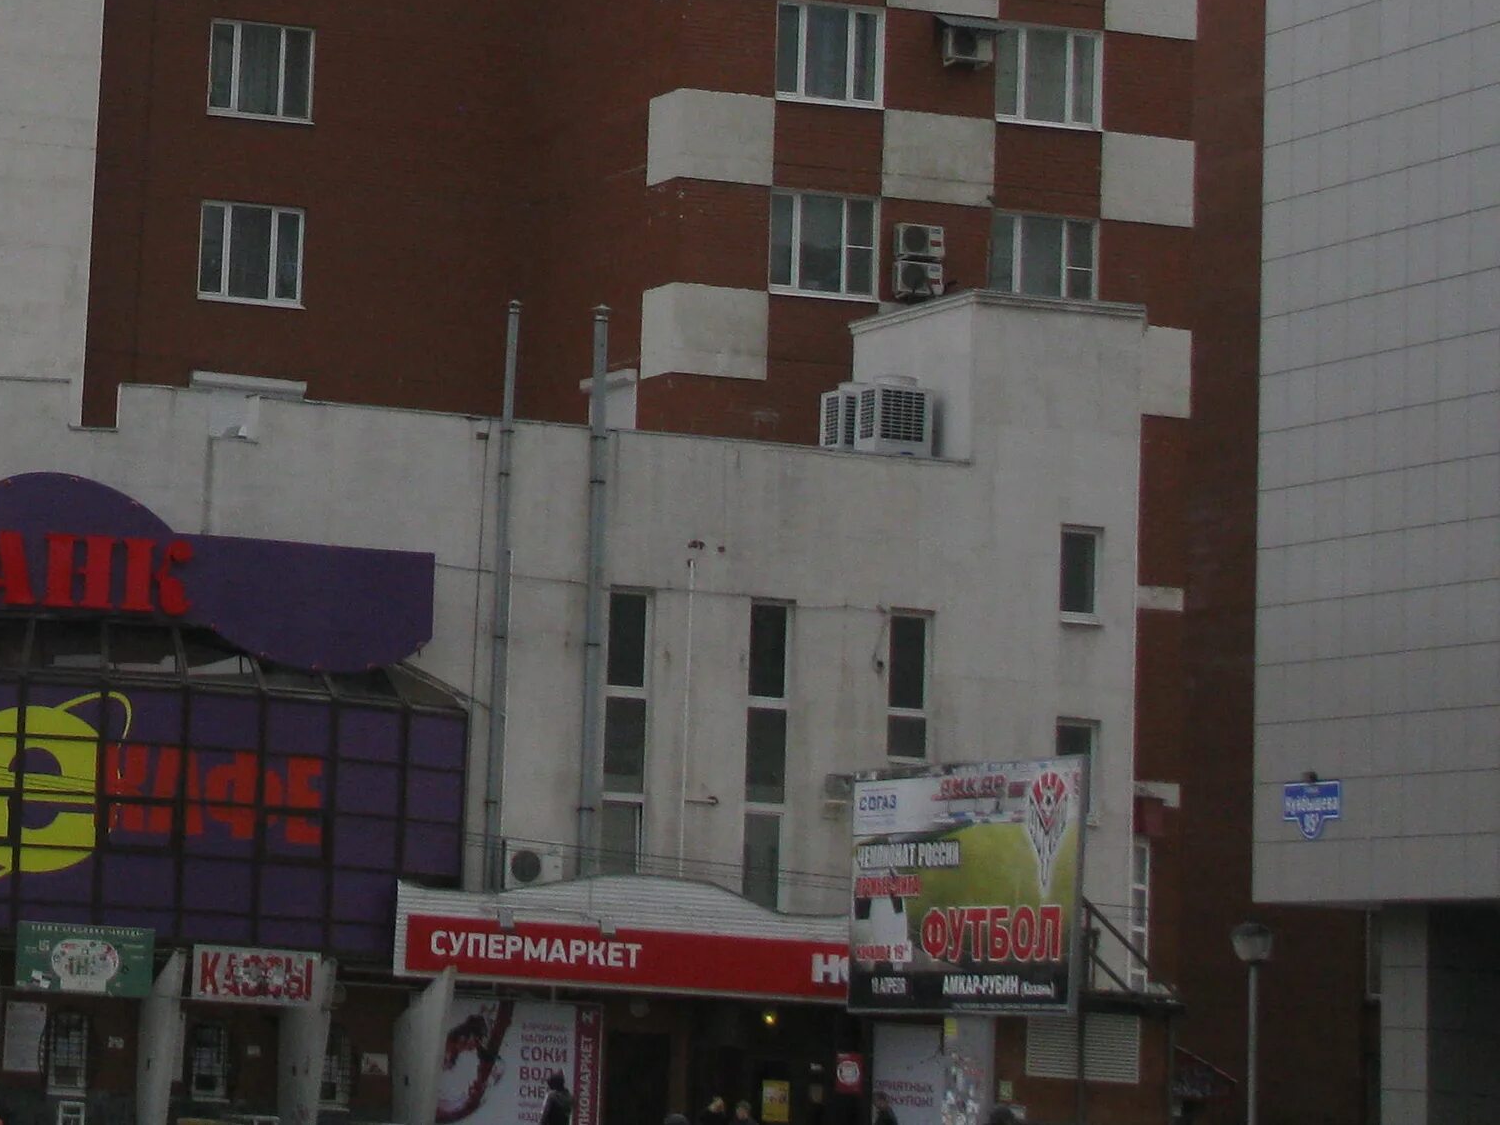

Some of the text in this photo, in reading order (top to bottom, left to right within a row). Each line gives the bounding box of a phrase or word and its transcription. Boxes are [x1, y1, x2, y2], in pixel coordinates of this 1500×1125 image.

[106, 741, 323, 846] КАФЕ
[859, 794, 897, 812] СОГАЗ
[857, 841, 961, 868] ЧЕМПИОНАТ РОССИИ
[921, 905, 1062, 963] ФУТБОЛ
[430, 929, 642, 969] СУПЕРМАРКЕТ
[200, 951, 314, 1001] КАССЫ
[942, 974, 1019, 996] АМКАР-РУБИН
[521, 1033, 568, 1045] НАПИТКИ
[520, 1046, 568, 1063] СОКИ
